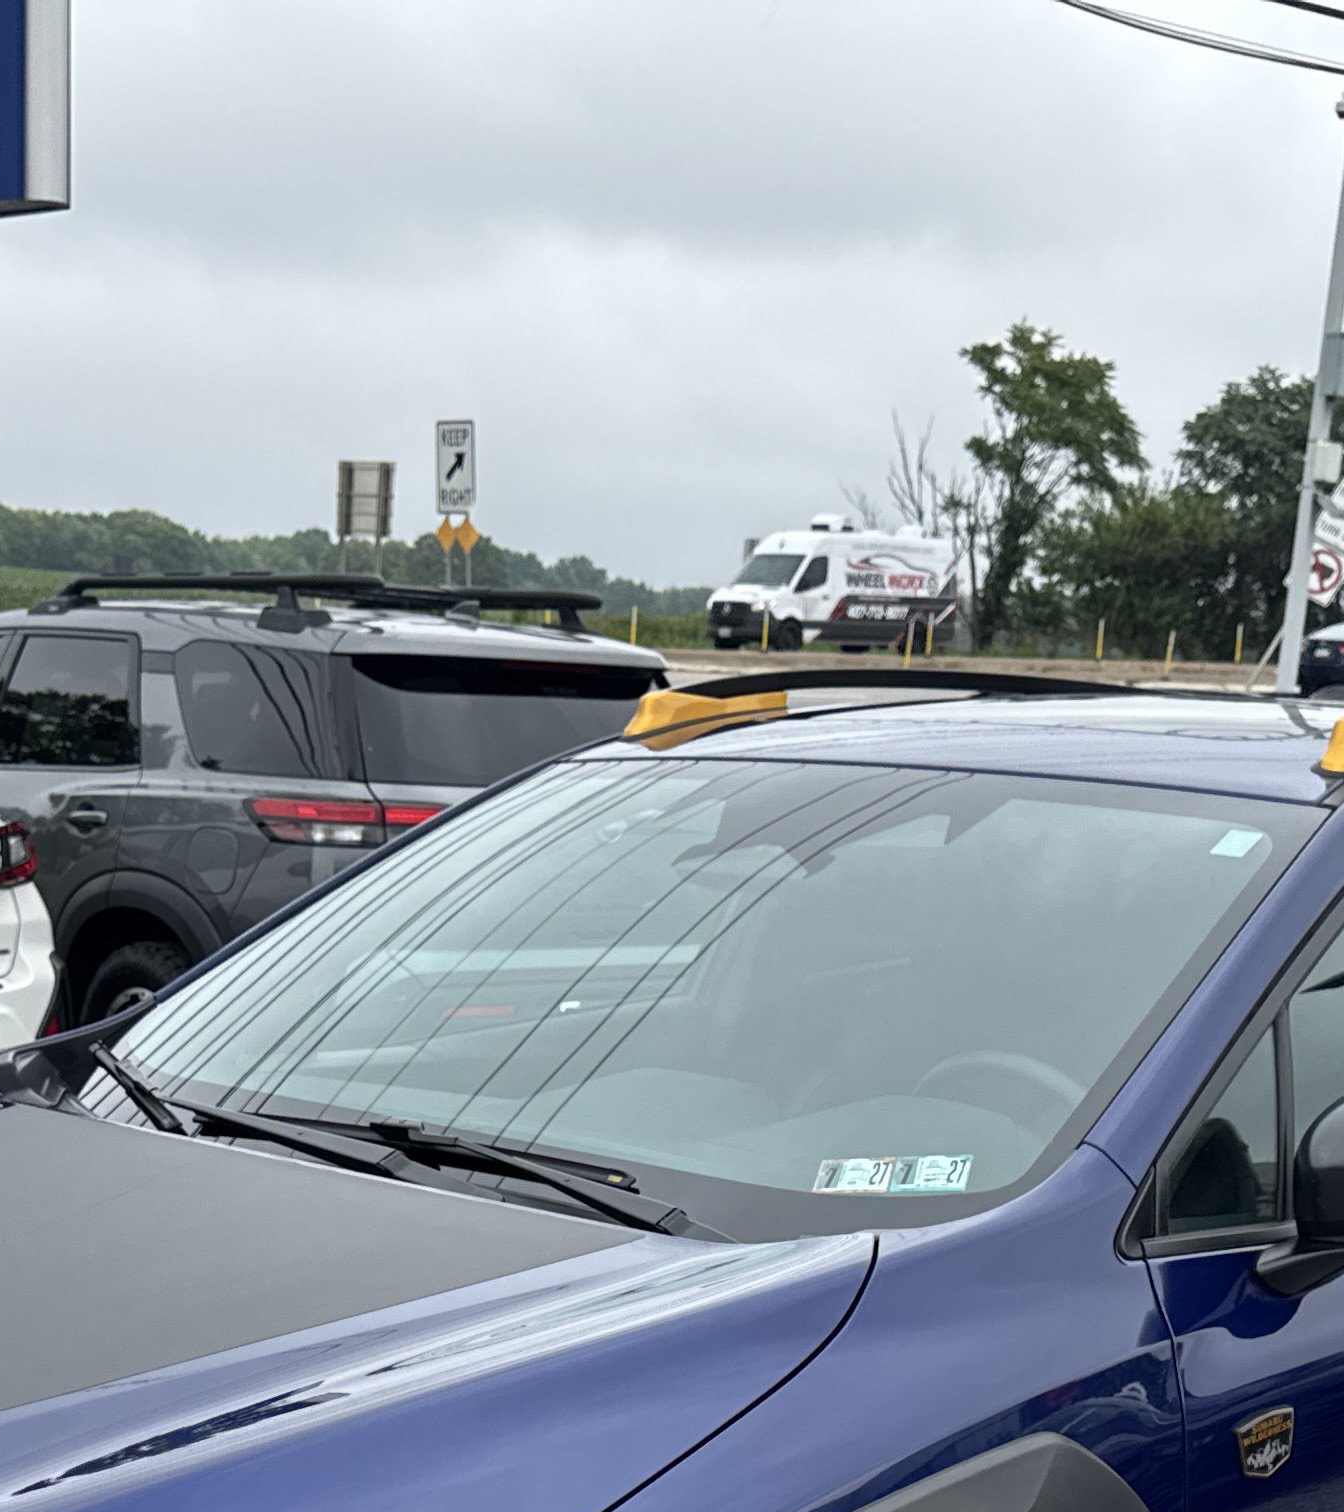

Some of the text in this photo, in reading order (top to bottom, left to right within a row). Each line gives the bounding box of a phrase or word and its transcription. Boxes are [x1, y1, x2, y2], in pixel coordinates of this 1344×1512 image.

[441, 428, 469, 447] KEEP
[441, 488, 471, 506] RIGHT
[868, 1161, 890, 1186] 27
[947, 1159, 967, 1184] 27
